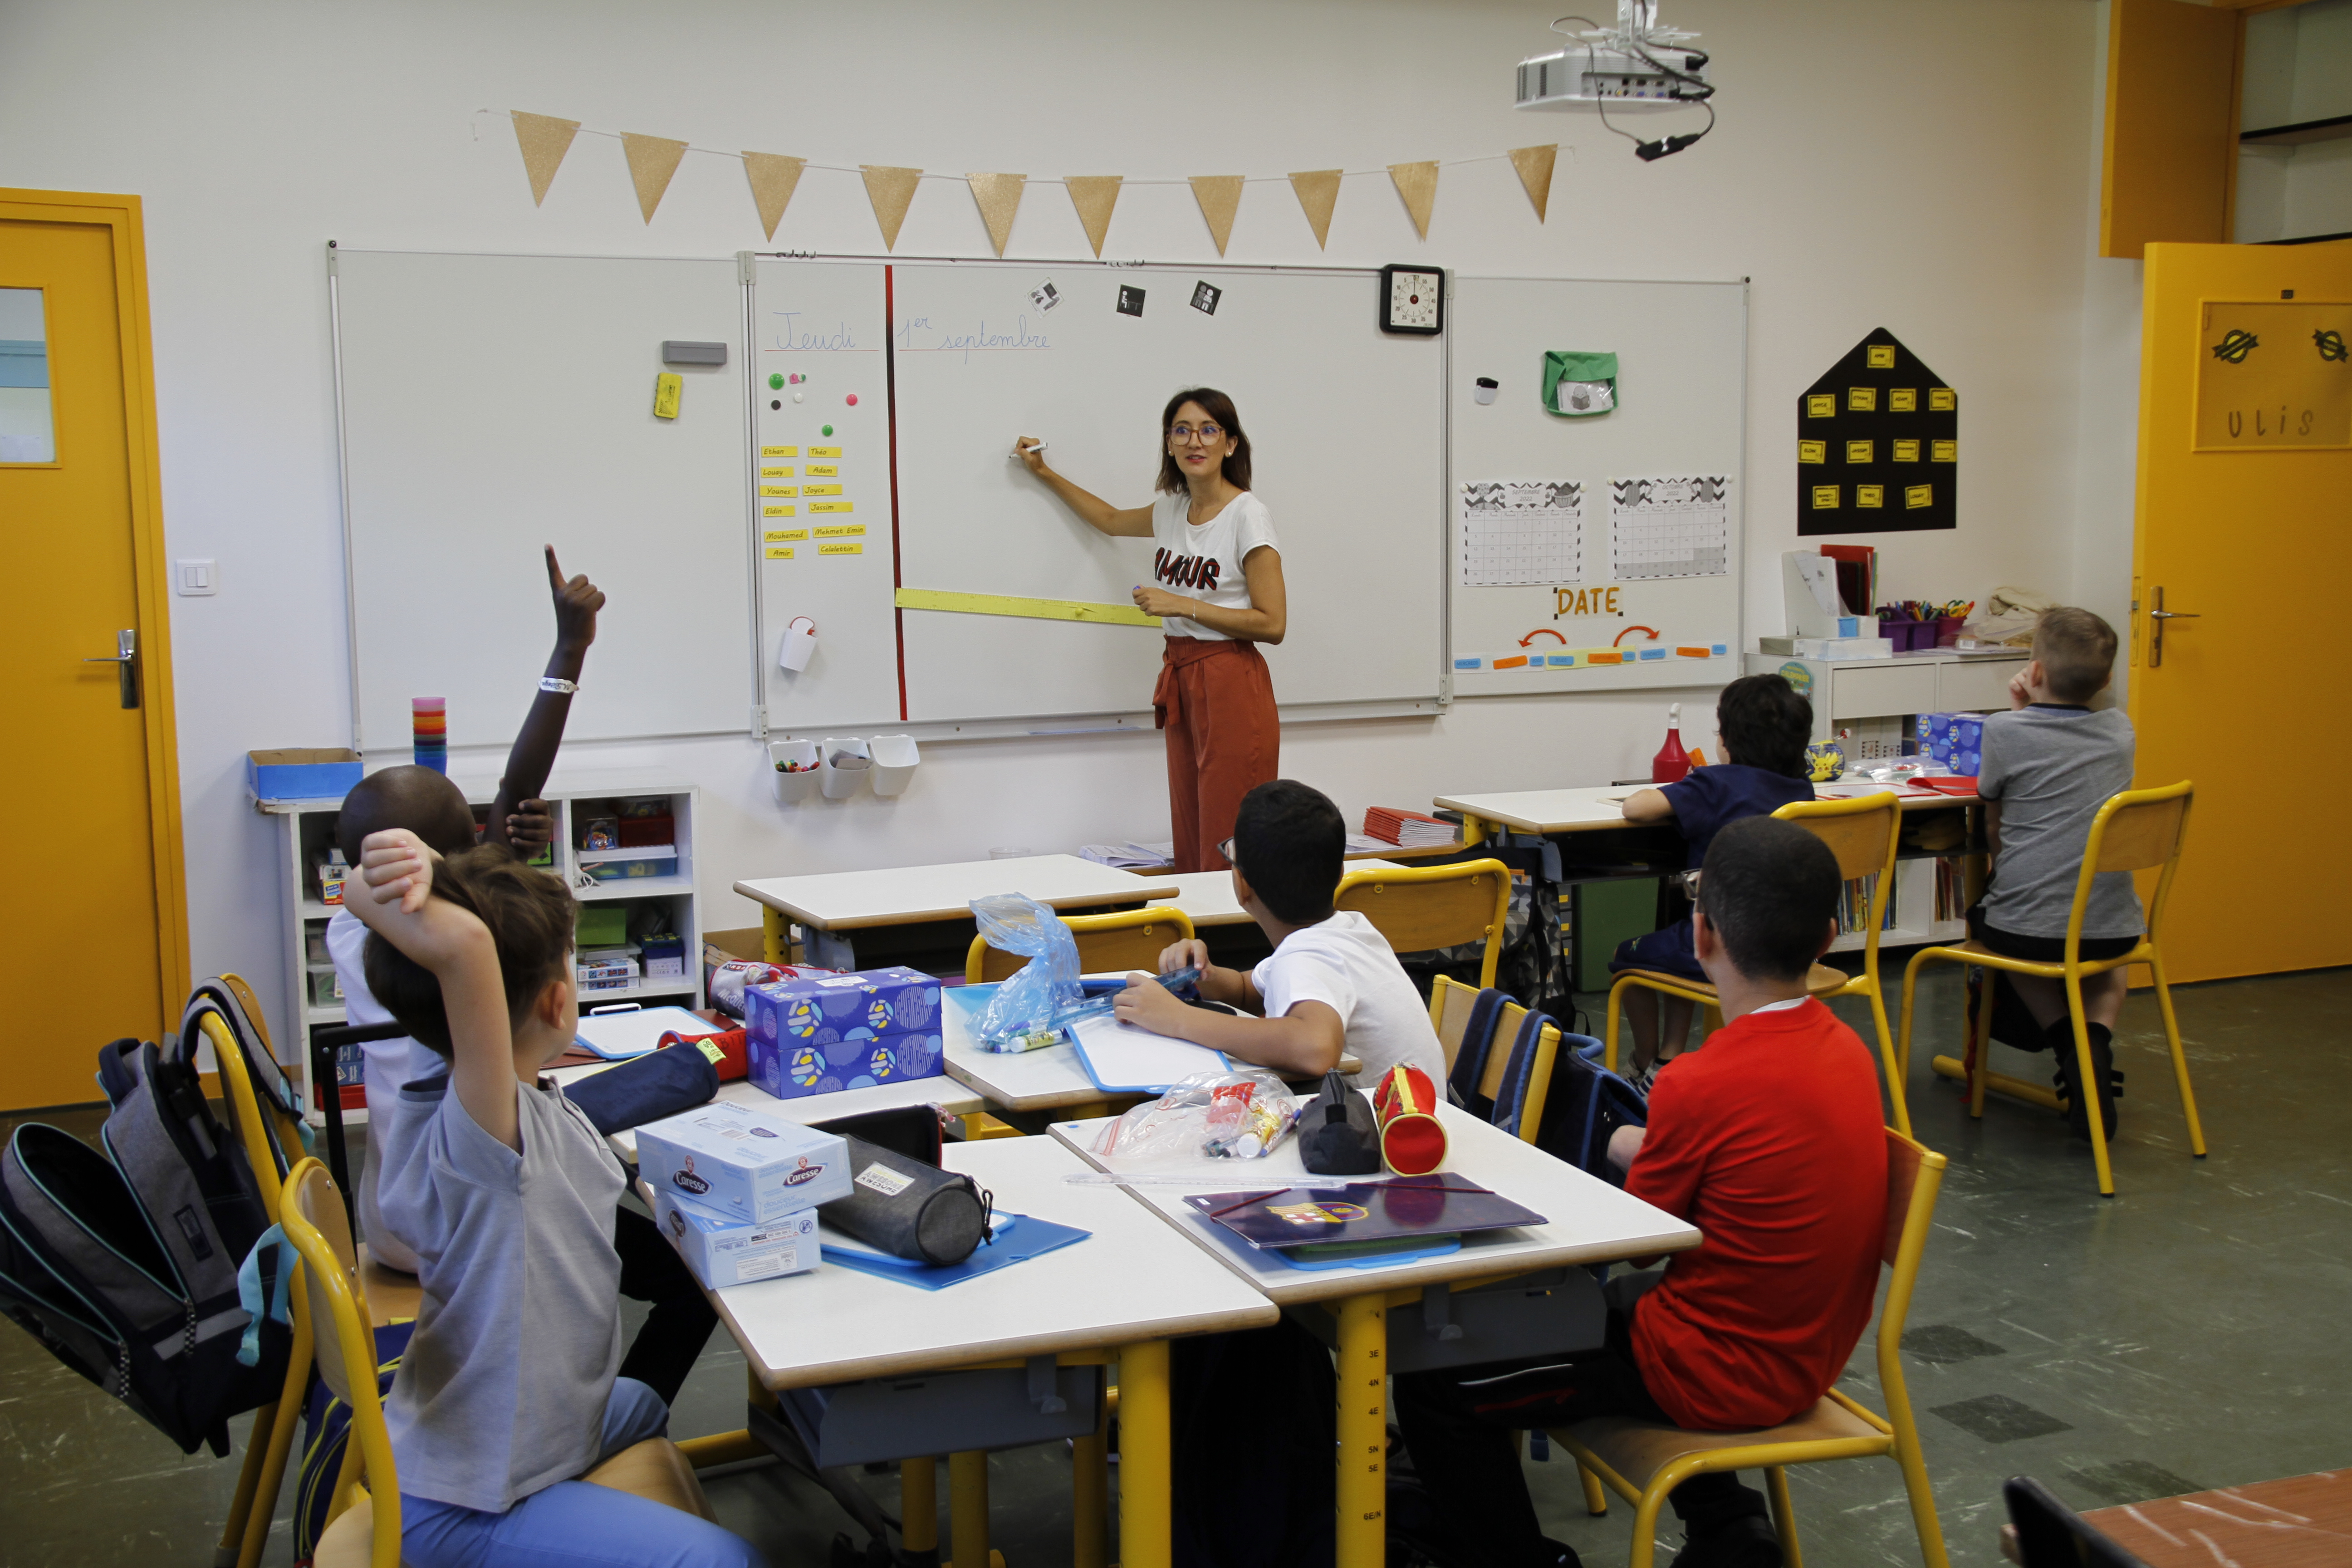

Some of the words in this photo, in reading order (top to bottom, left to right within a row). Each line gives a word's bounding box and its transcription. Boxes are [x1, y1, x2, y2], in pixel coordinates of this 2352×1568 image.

[773, 312, 856, 350] Jeudi
[897, 315, 933, 348] 1er
[937, 314, 1051, 365] septembre
[766, 531, 803, 539] Mouhamed
[1558, 587, 1620, 615] DATE
[787, 1168, 819, 1184] Caresse
[676, 1172, 706, 1192] Caresse
[860, 1176, 897, 1193] AWESOME
[764, 1195, 796, 1208] douceur
[764, 1198, 805, 1214] essentielle
[1369, 1349, 1379, 1357] 3E
[1368, 1378, 1379, 1387] 4N
[1368, 1407, 1379, 1415] 4E
[1368, 1445, 1378, 1454] 5N
[1368, 1464, 1378, 1472] 5E
[1363, 1510, 1381, 1520] 6E/N
